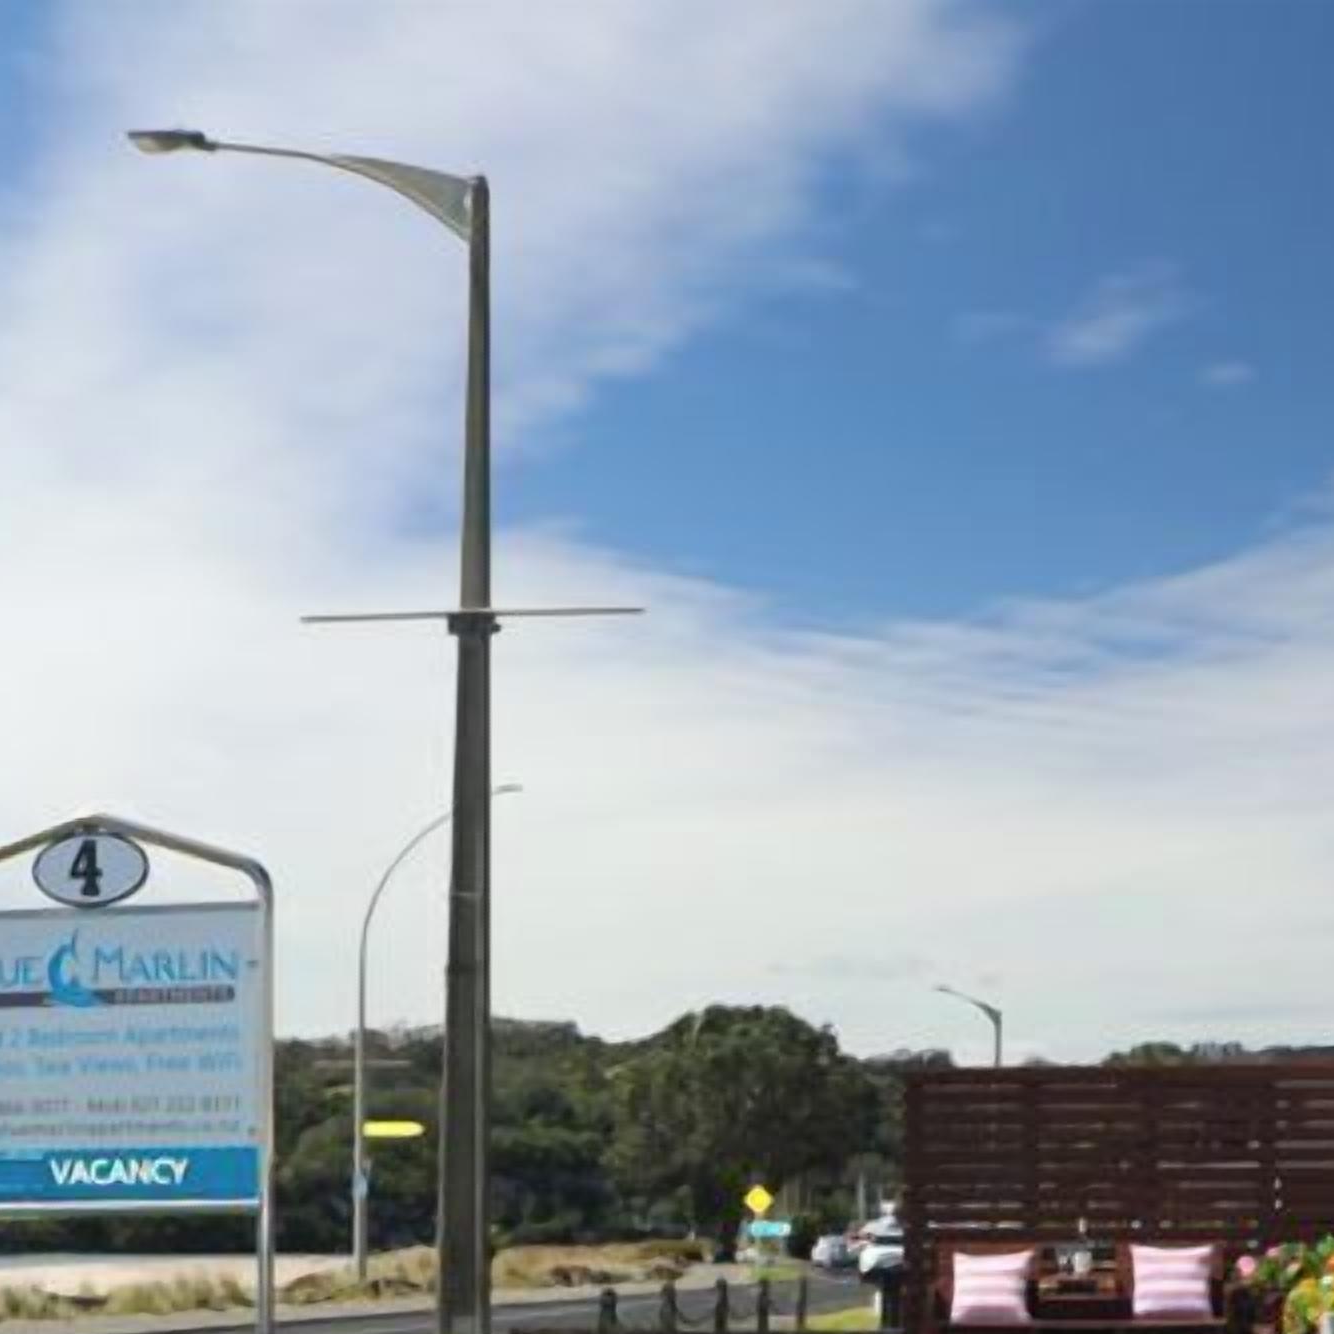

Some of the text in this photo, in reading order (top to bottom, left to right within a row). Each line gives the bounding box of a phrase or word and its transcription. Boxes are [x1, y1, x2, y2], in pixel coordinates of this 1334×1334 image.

[70, 839, 103, 897] 4
[93, 946, 238, 981] MARLIN
[49, 1158, 188, 1185] VACANCY
